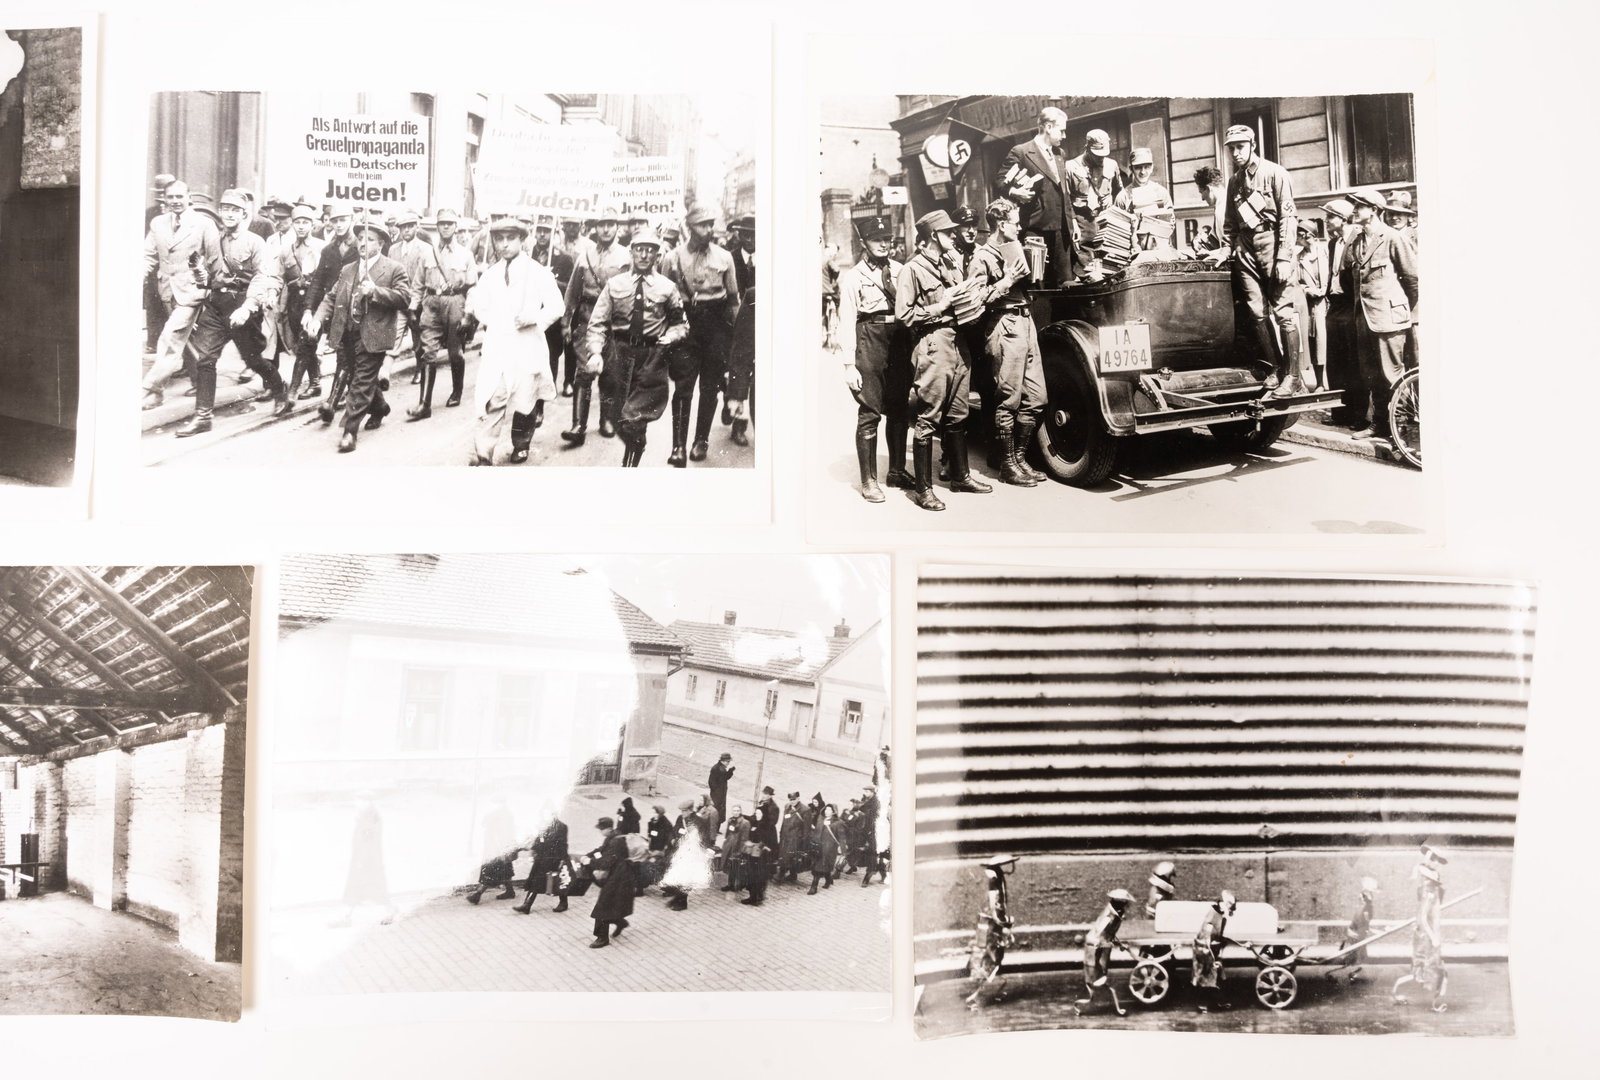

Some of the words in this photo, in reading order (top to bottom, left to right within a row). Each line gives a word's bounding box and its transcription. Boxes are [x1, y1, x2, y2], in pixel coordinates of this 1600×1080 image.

[312, 117, 331, 132] Als
[333, 118, 377, 135] Antwort
[379, 120, 398, 135] auf
[401, 120, 419, 136] die
[305, 134, 425, 157] Greuelpropaganda
[333, 159, 348, 169] kein
[349, 157, 418, 171] Deutscher
[325, 179, 407, 202] Juden!
[516, 188, 600, 213] Juden!
[621, 200, 675, 215] Juden!
[1104, 348, 1148, 368] 49764
